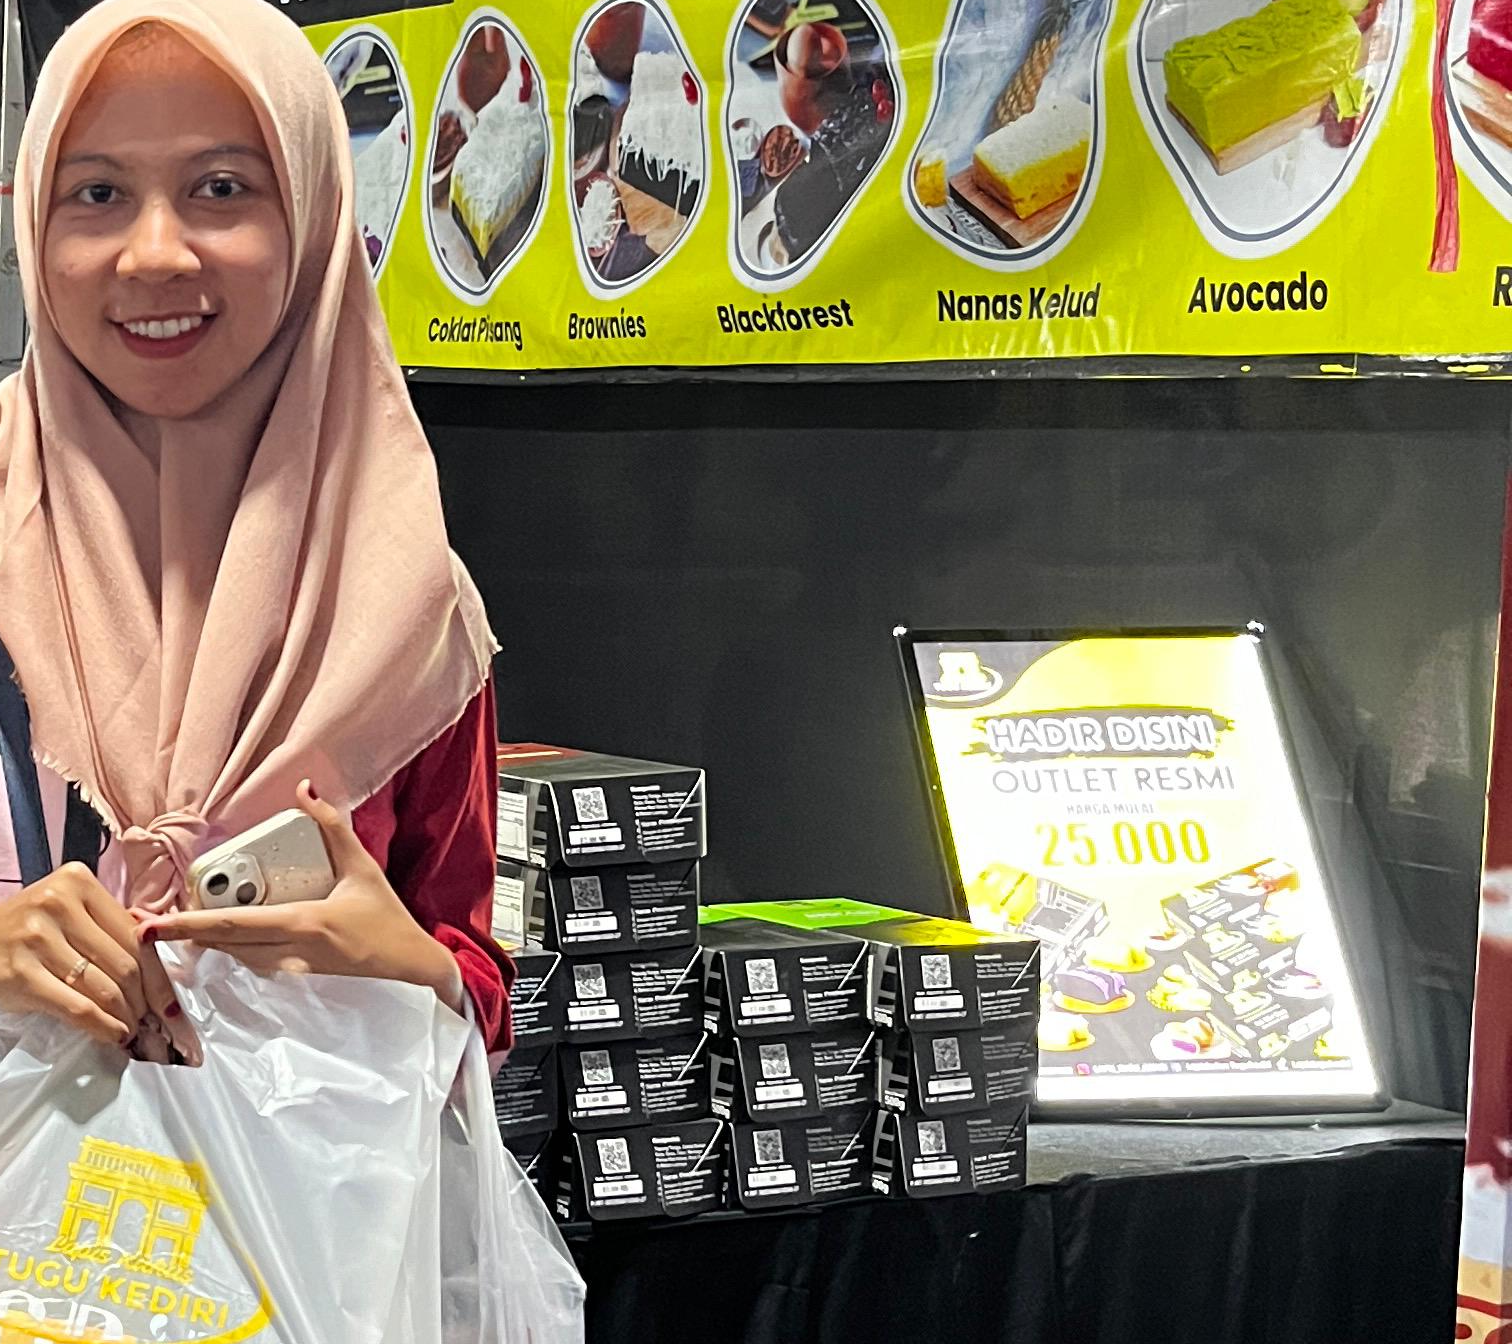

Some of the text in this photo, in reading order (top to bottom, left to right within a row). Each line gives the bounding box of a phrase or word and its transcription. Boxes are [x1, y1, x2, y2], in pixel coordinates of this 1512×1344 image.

[937, 282, 1101, 323] Nanas Kelud
[1188, 270, 1329, 315] Avocado
[428, 316, 476, 343] Coklat
[568, 307, 647, 340] Brownies
[716, 297, 854, 334] Blackforest
[990, 716, 1215, 752] HADIR DISINI
[993, 765, 1235, 794] OUTLET RESMI
[99, 1274, 229, 1329] KEDIRI
